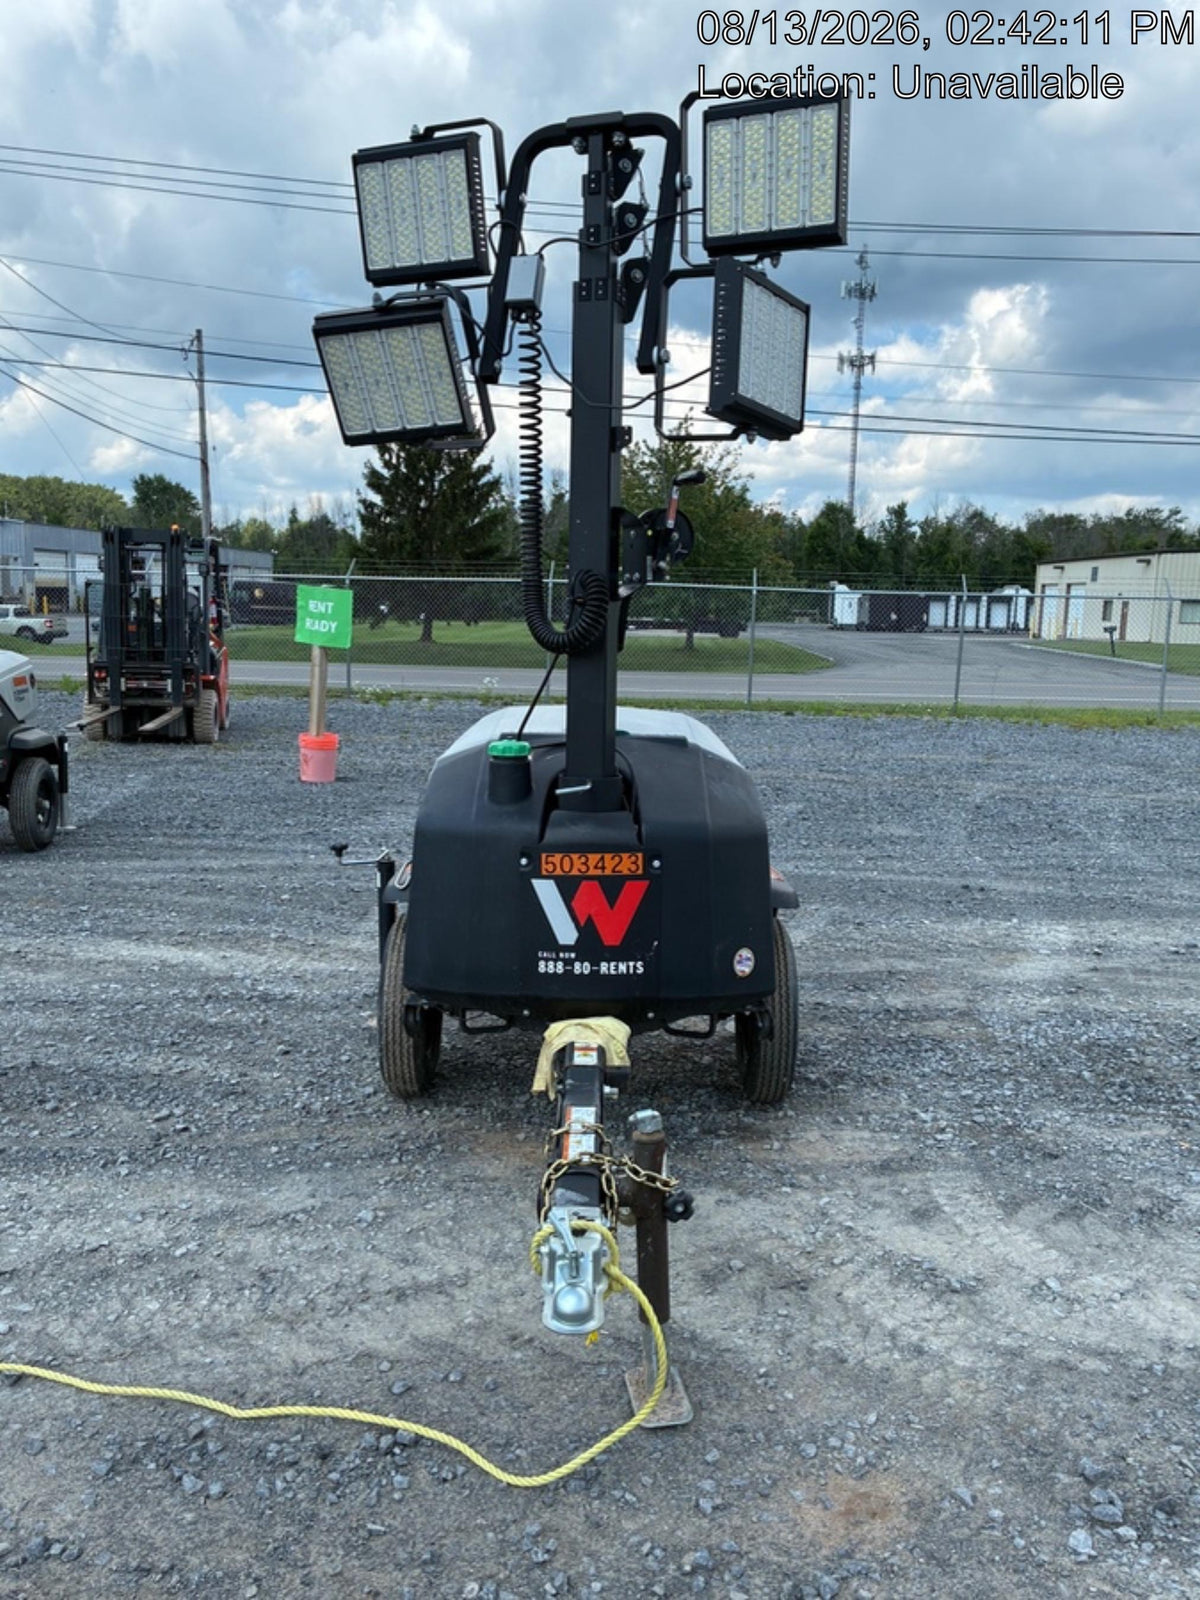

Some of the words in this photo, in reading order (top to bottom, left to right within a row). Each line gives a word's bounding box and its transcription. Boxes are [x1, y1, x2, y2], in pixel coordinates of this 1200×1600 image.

[544, 853, 640, 874] 503423
[538, 950, 556, 959] CALL
[537, 960, 644, 975] 888-80-RENTS
